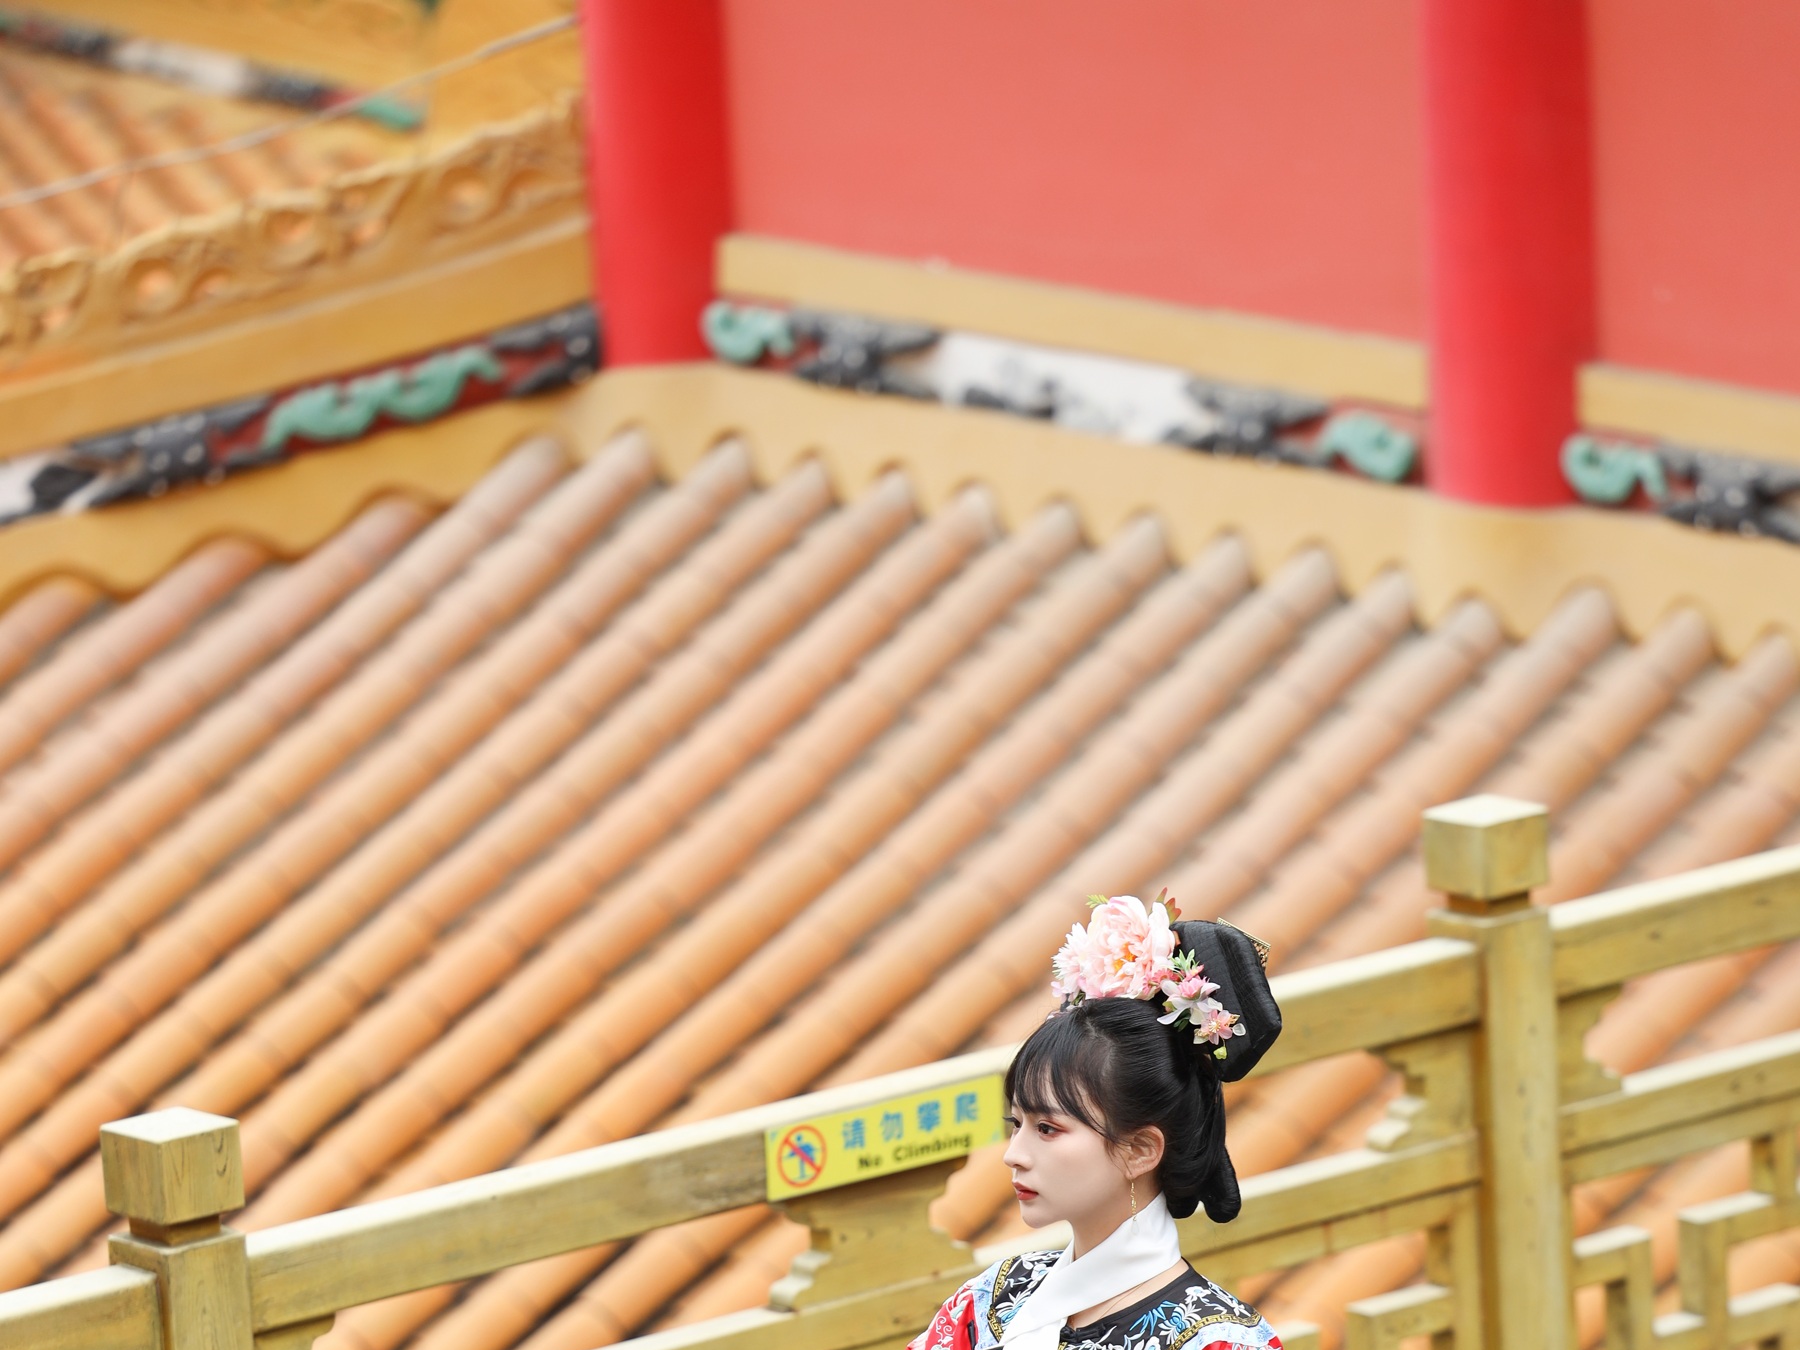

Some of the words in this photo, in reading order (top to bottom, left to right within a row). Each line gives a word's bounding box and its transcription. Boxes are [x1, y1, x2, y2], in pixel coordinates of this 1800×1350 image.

[842, 1092, 979, 1150] 请勿攀爬
[857, 1154, 883, 1171] No
[892, 1133, 973, 1162] Climbing
